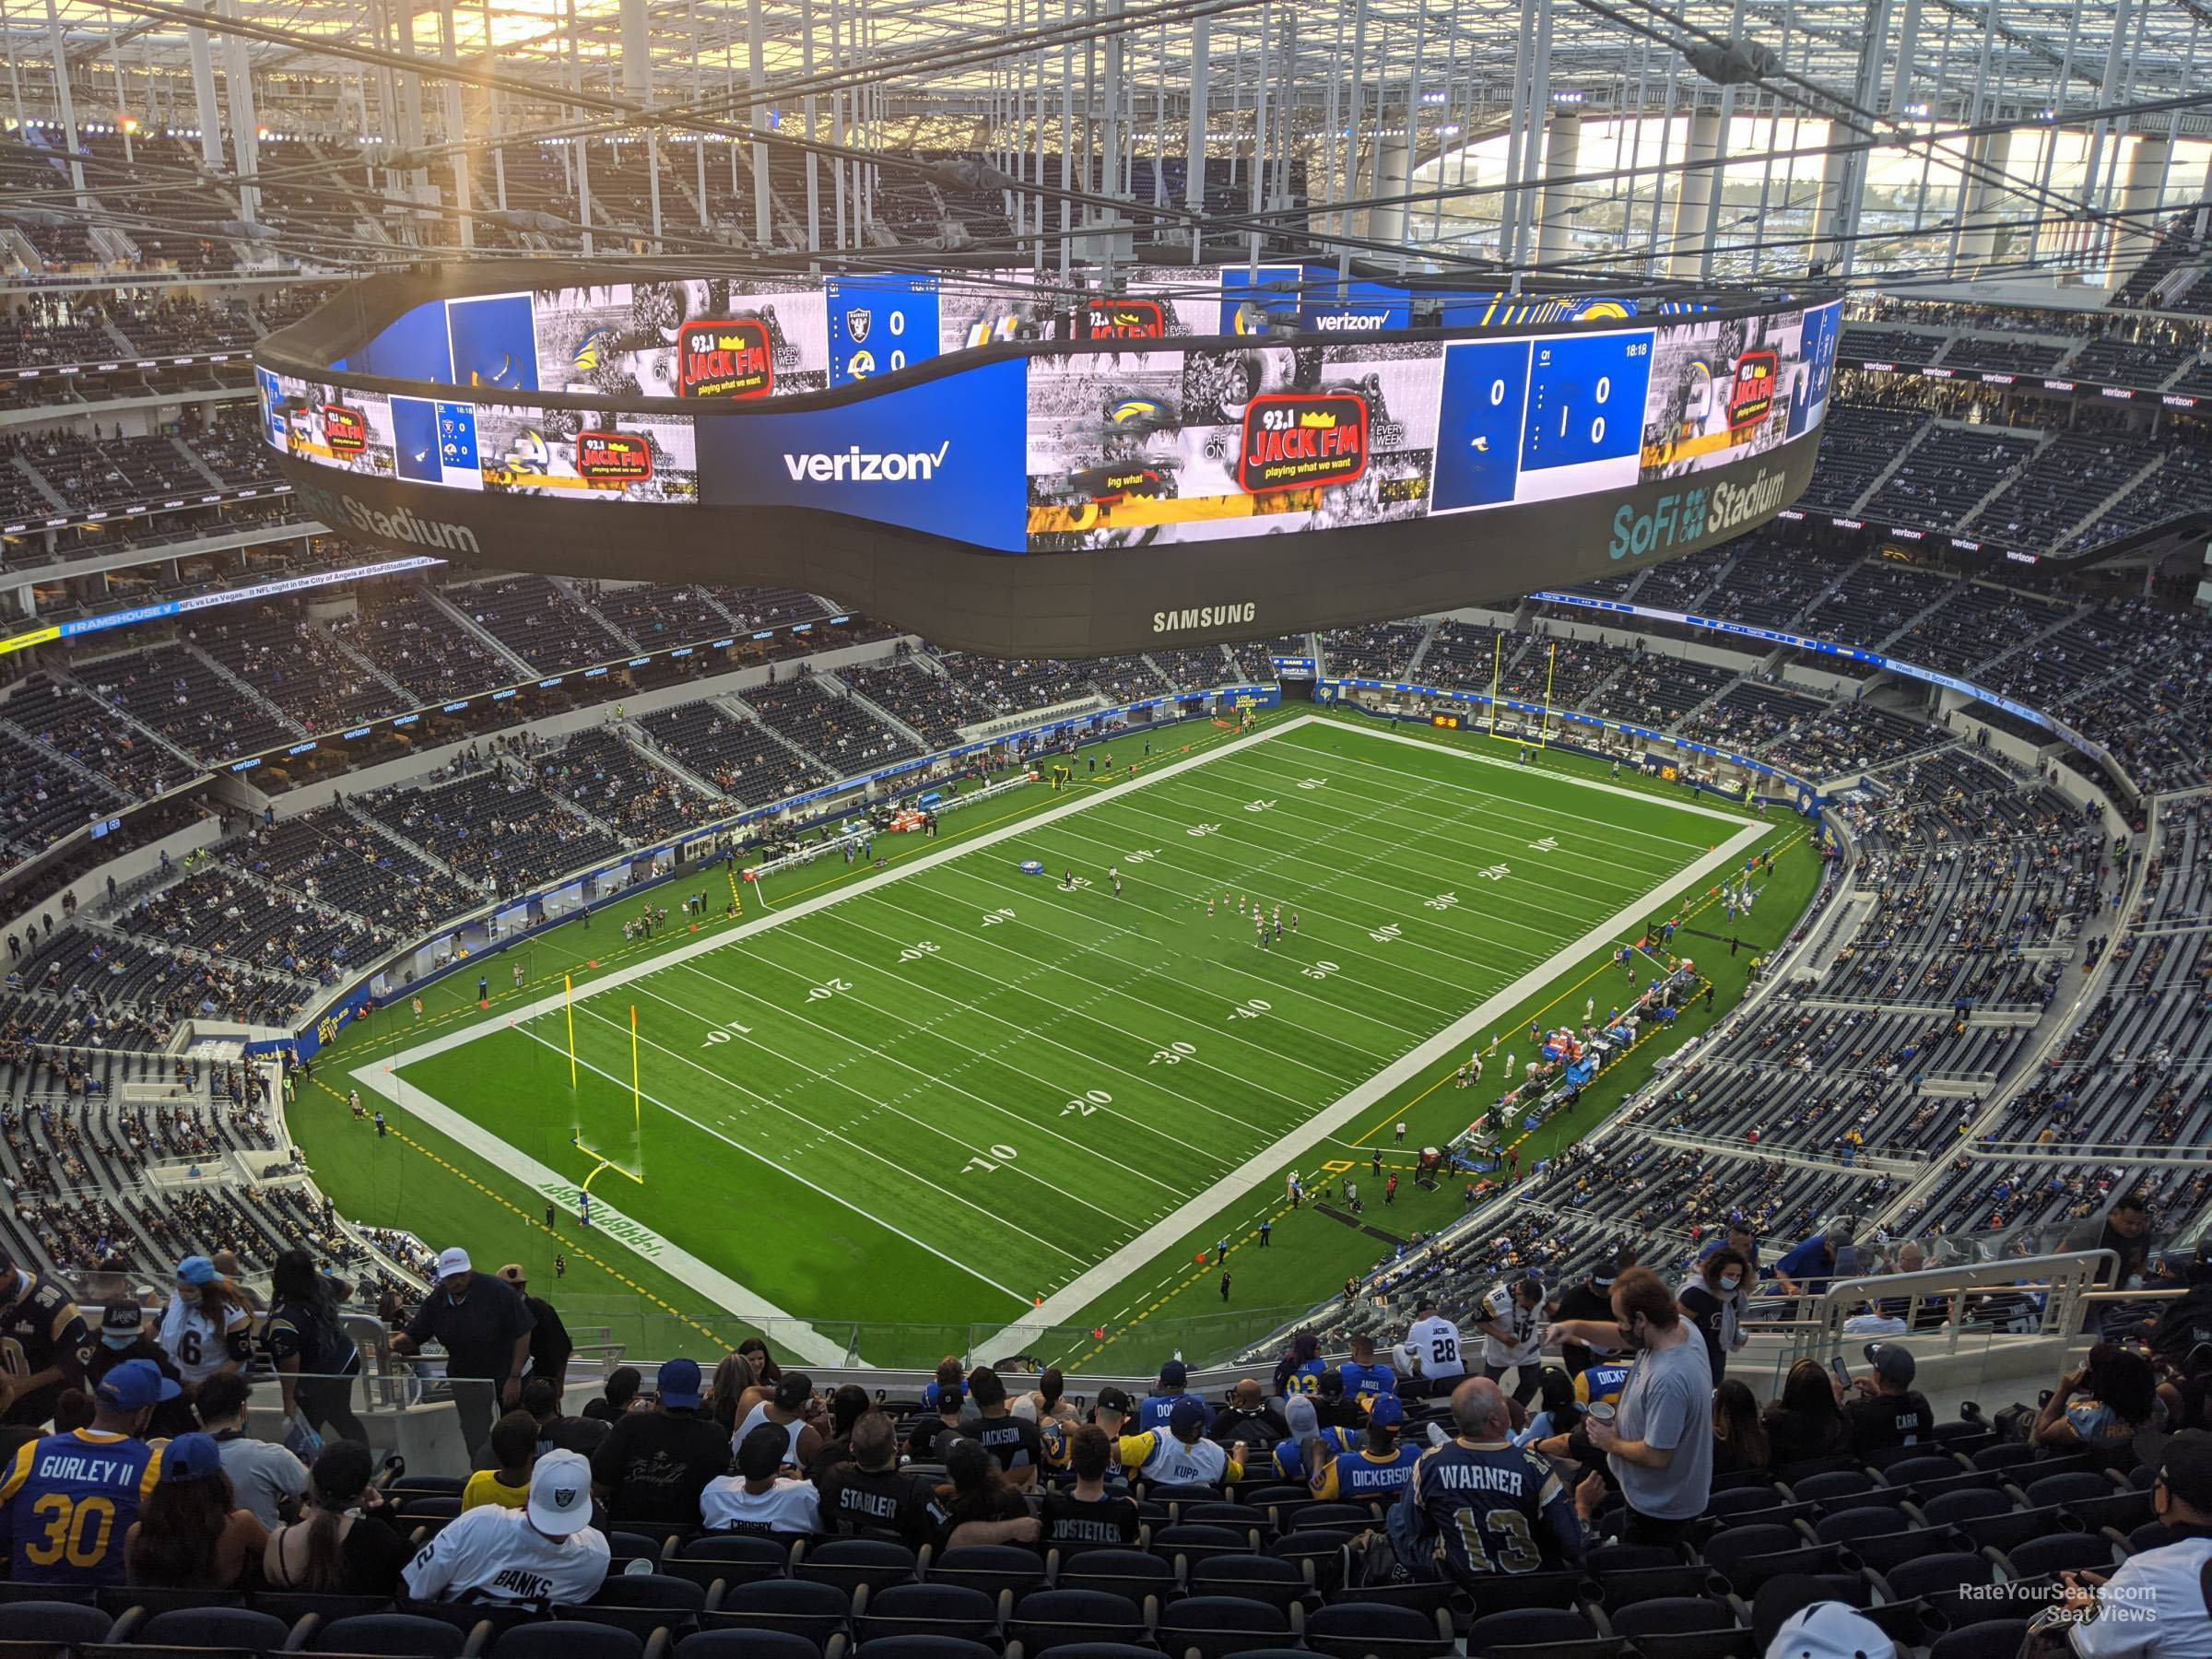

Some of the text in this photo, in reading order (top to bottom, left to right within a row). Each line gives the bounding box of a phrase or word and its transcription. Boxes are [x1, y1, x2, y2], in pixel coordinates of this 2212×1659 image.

[889, 311, 904, 335] 0
[1316, 313, 1382, 331] verizon
[691, 335, 714, 354] 93.1
[778, 347, 800, 357] EVERY
[1626, 343, 1648, 358] 18:18
[686, 347, 765, 385] JACK FM
[779, 355, 800, 364] WEEK
[890, 350, 905, 371] 0
[1864, 361, 1893, 371] verizon
[18, 370, 40, 378] verizon
[654, 368, 668, 379] ON
[1923, 367, 1952, 377] verizon
[1982, 373, 2013, 383] verizon
[698, 382, 720, 396] playing
[721, 381, 736, 392] what
[746, 376, 761, 386] want
[1491, 379, 1505, 406] 0
[1596, 376, 1610, 404] 0
[2043, 380, 2073, 391] verizon
[2101, 386, 2131, 398] verizon
[2162, 394, 2194, 406] verizon
[456, 406, 473, 415] 18:18
[1264, 408, 1294, 429] 93.1
[459, 423, 465, 432] 0
[1376, 425, 1404, 437] EVERY
[1591, 417, 1606, 444] 0
[587, 440, 605, 450] 93.1
[1206, 435, 1226, 445] ARE
[1249, 424, 1359, 466] JACK FM
[1376, 433, 1404, 446] WEEK
[462, 446, 468, 455] 0
[582, 449, 620, 466] JACK
[621, 451, 645, 466] FM
[1205, 444, 1226, 459] ON
[783, 446, 933, 481] verizon
[1265, 458, 1351, 480] playing what we want
[1123, 474, 1143, 486] what
[238, 489, 257, 498] verizon
[274, 485, 291, 493] verizon
[164, 500, 184, 508] verizon
[201, 495, 221, 503] verizon
[87, 512, 108, 520] verizon
[125, 505, 147, 514] verizon
[1609, 467, 1785, 559] SoFi Stadium
[1778, 510, 1803, 520] erizon
[4, 524, 26, 533] verizon
[46, 517, 67, 526] verizon
[343, 494, 480, 553] Stadium
[1833, 517, 1862, 529] verizon
[1891, 528, 1921, 540] verizon
[1951, 538, 1980, 551] verizon
[2006, 550, 2036, 564] verizon
[180, 601, 194, 611] NFL
[195, 600, 205, 608] vs
[206, 596, 219, 606] Las
[256, 585, 270, 595] NFL
[271, 581, 289, 594] night
[298, 577, 310, 587] the
[311, 574, 324, 587] City
[334, 568, 358, 582] Angels
[68, 606, 161, 634] #RAMSHOUSE
[830, 615, 850, 625] verizon
[1153, 602, 1255, 632] SAMSUNG
[792, 622, 812, 632] verizon
[752, 630, 773, 640] verizon
[712, 638, 734, 648] verizon
[671, 647, 693, 657] verizon
[629, 656, 651, 667] verizon
[584, 667, 607, 677] verizon
[1896, 663, 1913, 674] Week
[1932, 674, 1954, 687] Scores
[539, 677, 562, 688] verizon
[492, 688, 516, 700] verizon
[443, 700, 468, 712] verizon
[393, 713, 419, 725] verizon
[1435, 716, 1457, 728] 18:18
[343, 726, 371, 739] verizon
[289, 741, 317, 756] verizon
[232, 757, 261, 772] verizon
[1297, 778, 1328, 790] 10
[1243, 799, 1275, 813] 20
[1186, 823, 1219, 837] 30
[1528, 838, 1559, 853] 10
[1124, 849, 1156, 865] 40
[1477, 865, 1511, 881] 20
[1056, 877, 1093, 892] 50
[1424, 894, 1459, 911] 30
[982, 908, 1017, 924] 40
[1369, 925, 1402, 943] 40
[900, 941, 941, 959] 30
[1300, 960, 1340, 980] 50
[808, 977, 853, 1000] 20
[1236, 999, 1272, 1019] 40
[707, 1020, 753, 1044] 10
[1153, 1041, 1196, 1065] 30
[1065, 1089, 1112, 1117] 20
[970, 1144, 1018, 1173] 10
[1432, 1327, 1450, 1335] JACOBS
[1432, 1339, 1456, 1364] 28
[1360, 1380, 1379, 1391] ANGEL
[1896, 1414, 1919, 1430] CARR
[982, 1428, 1021, 1447] JACKSON
[40, 1455, 135, 1487] GURLEY II
[1174, 1465, 1199, 1480] KUPP
[1352, 1465, 1414, 1488] DICKERSON
[1439, 1465, 1523, 1497] WARNER
[840, 1488, 899, 1519] STABLER
[25, 1492, 116, 1568] 30
[730, 1518, 772, 1533] CROSBY
[1453, 1507, 1542, 1573] 13
[493, 1570, 554, 1598] BANKS
